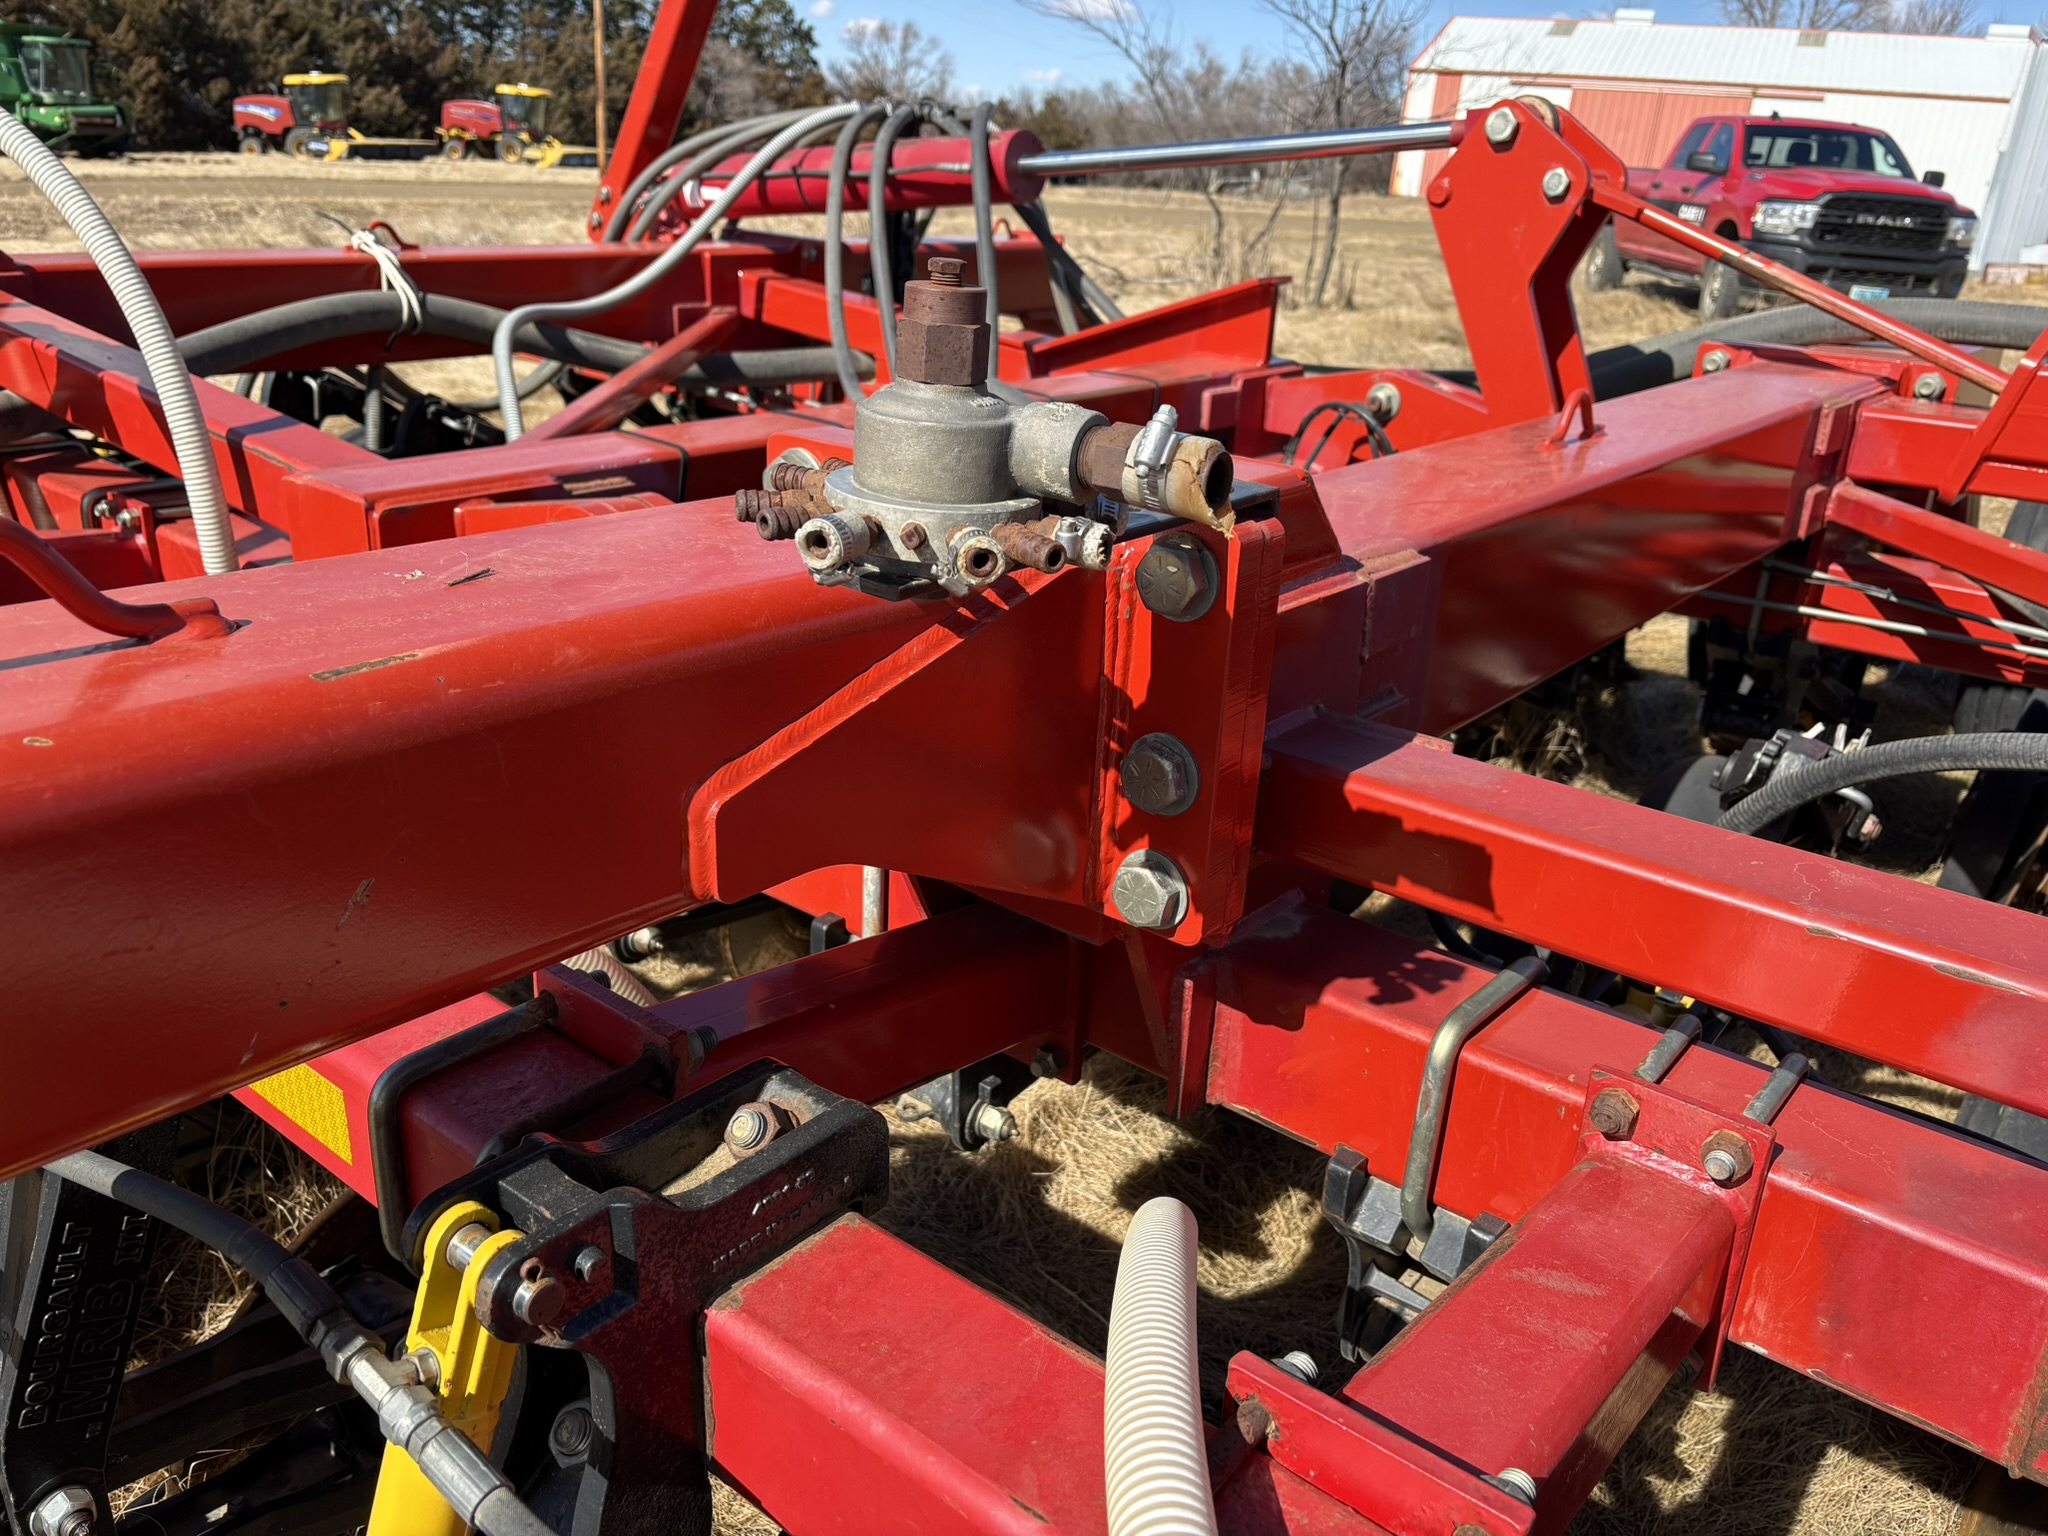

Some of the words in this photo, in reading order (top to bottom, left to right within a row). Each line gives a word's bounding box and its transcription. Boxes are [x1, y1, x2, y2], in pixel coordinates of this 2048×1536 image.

[1855, 213, 1918, 228] RAM
[18, 1222, 93, 1428] BOURGAULT
[56, 1279, 134, 1422] MRB
